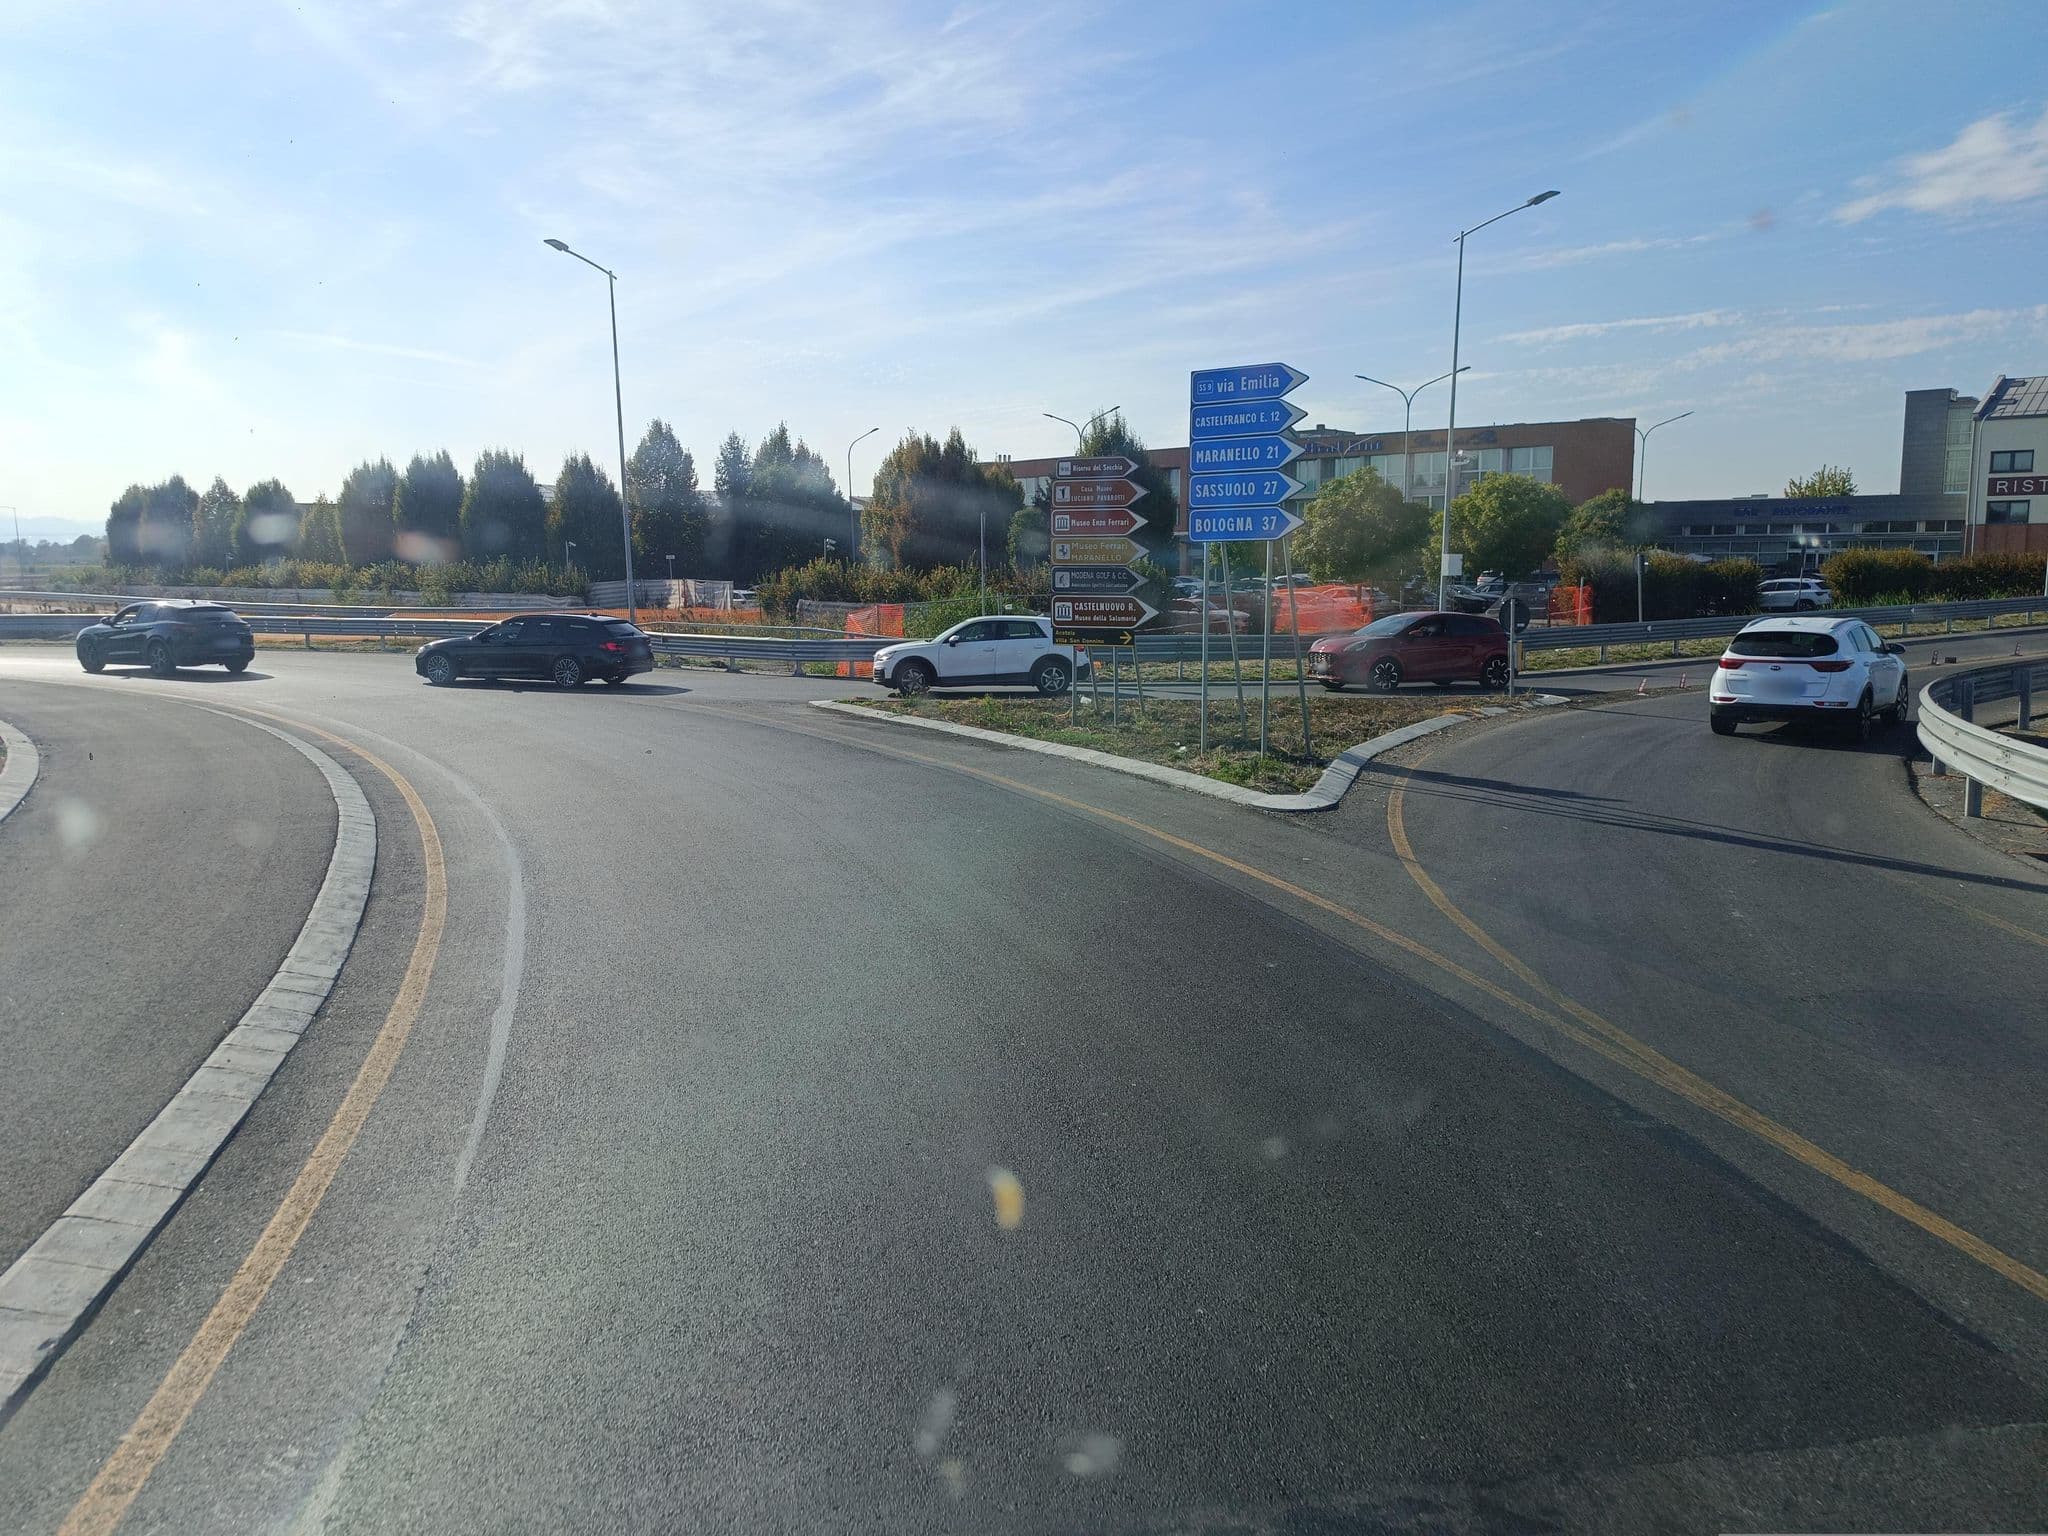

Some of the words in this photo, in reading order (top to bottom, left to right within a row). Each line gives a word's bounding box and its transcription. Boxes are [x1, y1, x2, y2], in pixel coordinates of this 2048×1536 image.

[1217, 378, 1234, 392] via
[1240, 375, 1280, 390] Emilia
[1195, 414, 1256, 428] CASTELFRANCO
[1260, 413, 1268, 422] E.
[1271, 411, 1280, 422] 12
[1196, 448, 1260, 462] MARANELLO
[1266, 446, 1279, 459] 21
[1196, 482, 1256, 498] SASSUOLO
[1263, 481, 1278, 494] 27
[1071, 518, 1090, 528] Museo
[1092, 518, 1106, 526] Enzo
[1108, 518, 1130, 526] Ferrari
[1195, 516, 1253, 532] BOLOGNA
[1262, 516, 1277, 530] 37
[1074, 602, 1125, 611] CASTELNUOVO
[1128, 602, 1136, 612] R.
